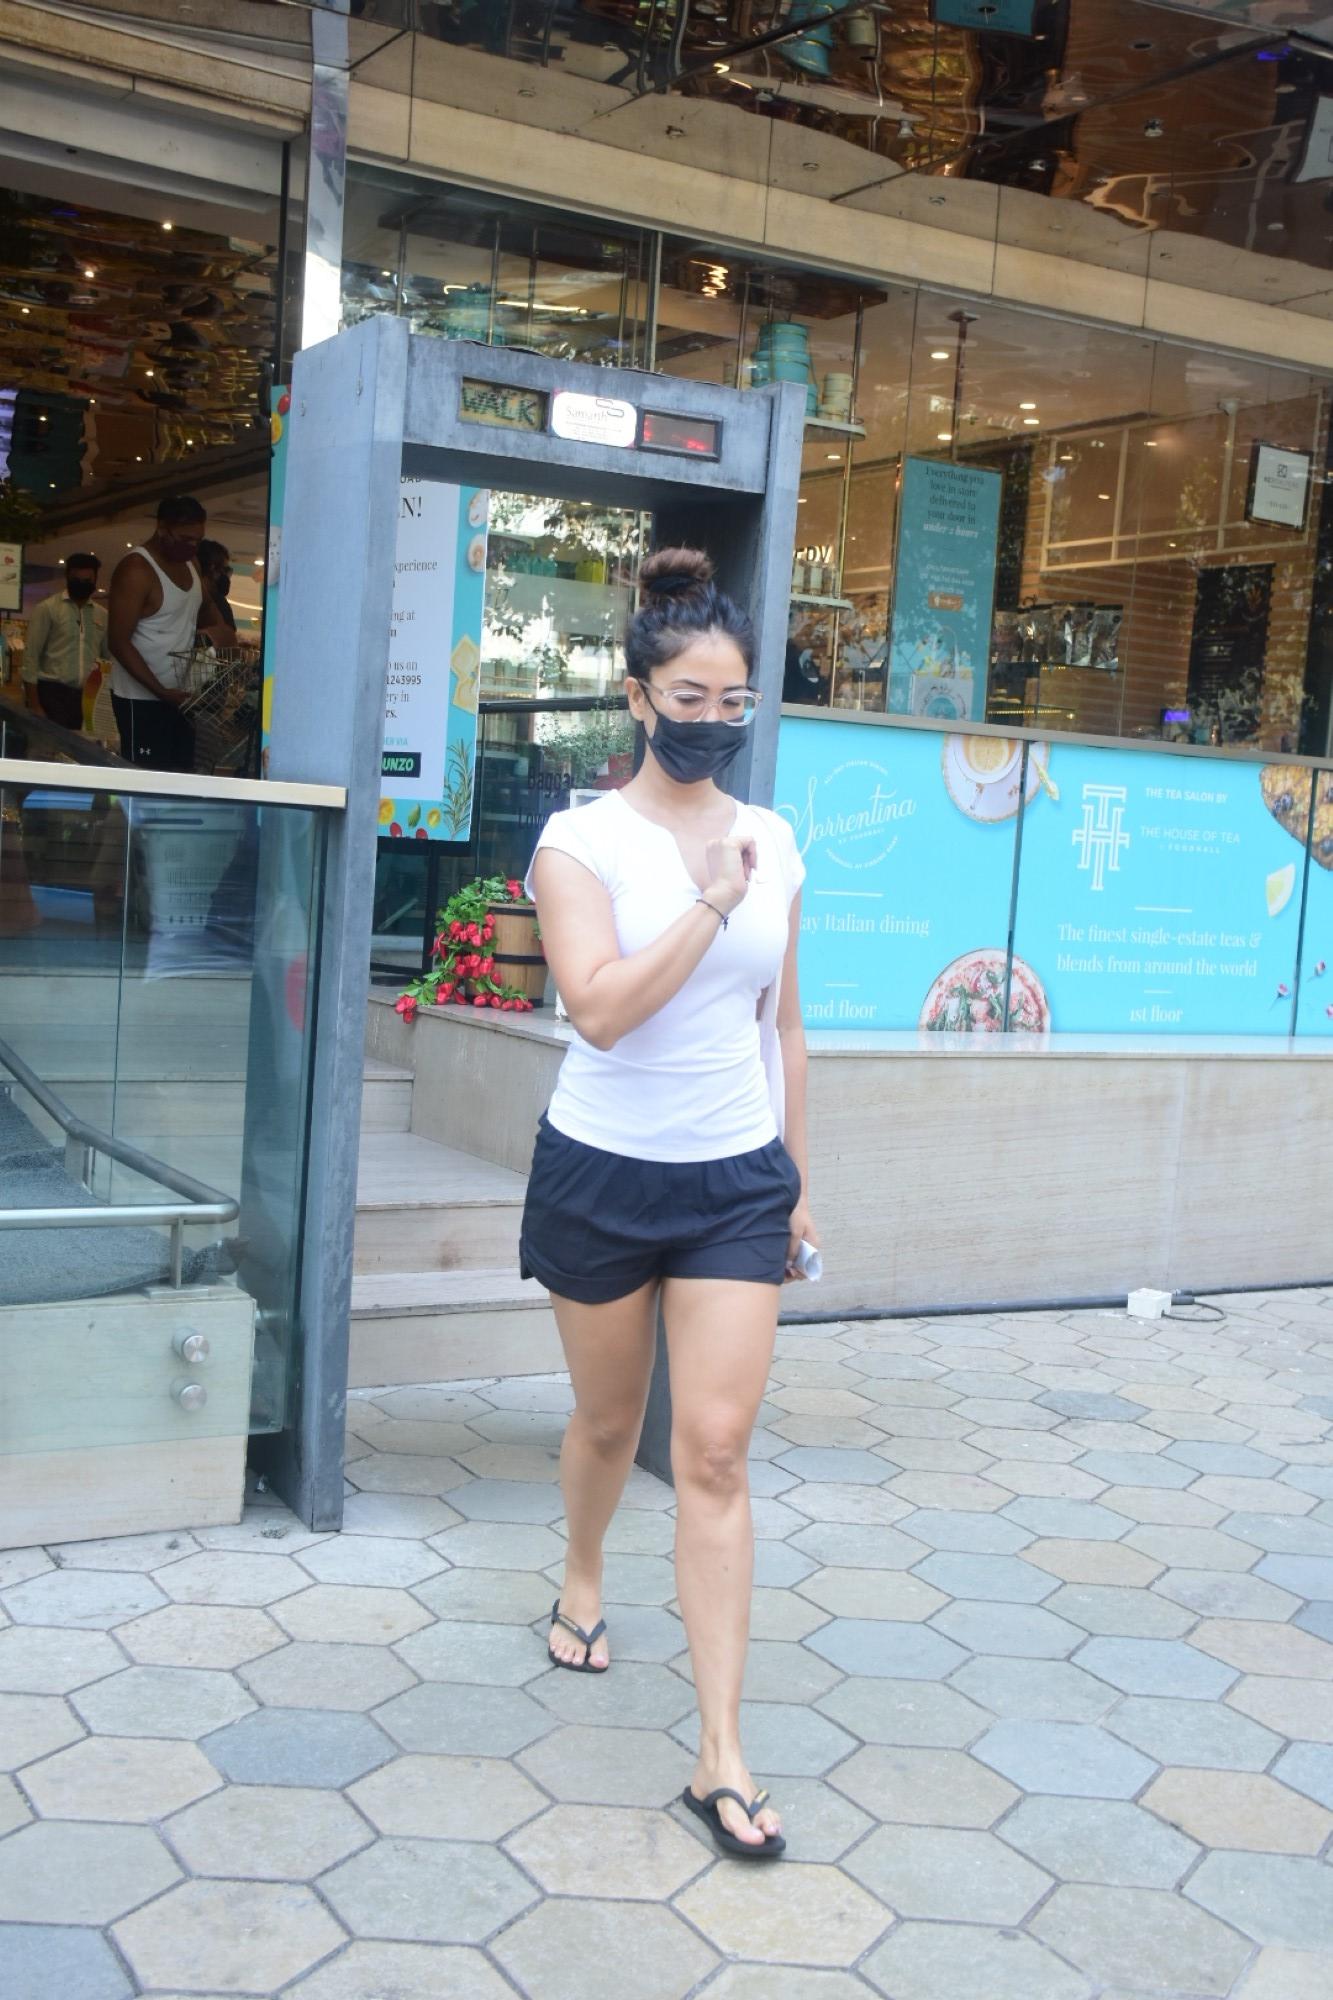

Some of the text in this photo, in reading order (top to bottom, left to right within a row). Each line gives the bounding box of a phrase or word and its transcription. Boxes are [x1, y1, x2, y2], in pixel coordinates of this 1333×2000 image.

[382, 757, 414, 772] UNZO
[1145, 787, 1163, 800] THE
[1165, 788, 1182, 801] TEA
[1183, 790, 1214, 803] SALON
[1140, 826, 1241, 844] THE HOUSE OF TEA
[824, 912, 876, 933] Italian
[880, 914, 930, 938] dining
[1058, 923, 1263, 949] The finest single-estate teas &
[1056, 954, 1258, 977] blends from around the world
[839, 999, 877, 1019] floor
[1150, 1004, 1184, 1023] floor
